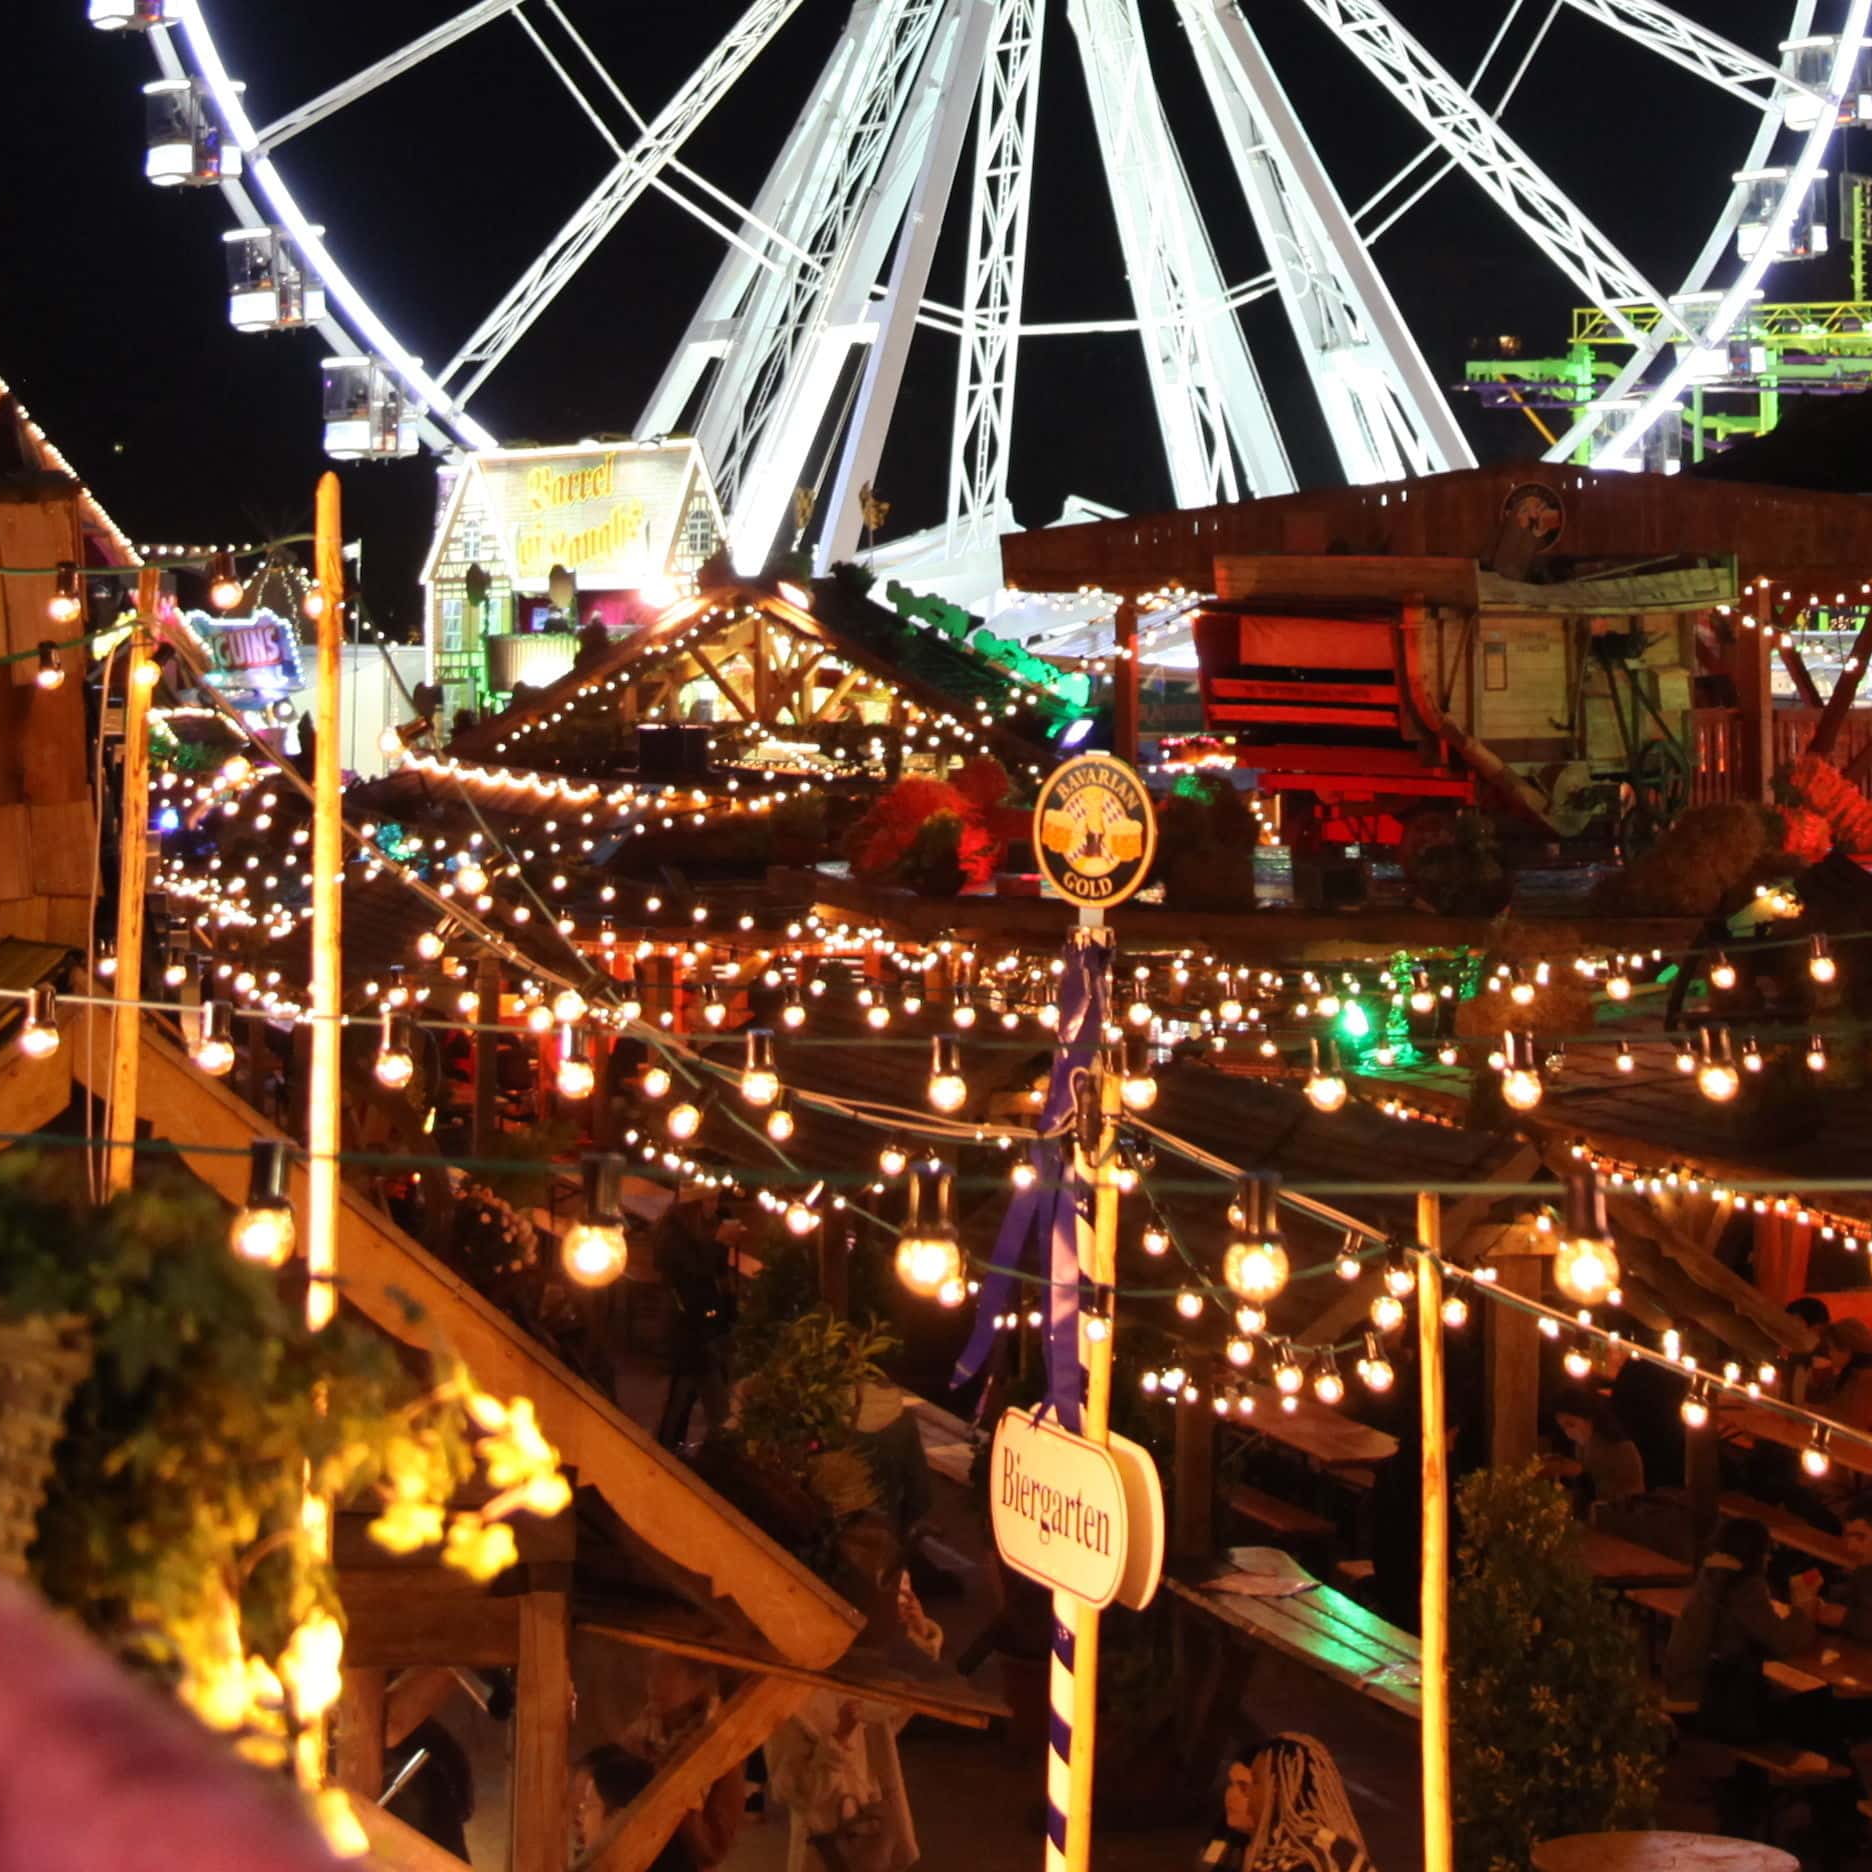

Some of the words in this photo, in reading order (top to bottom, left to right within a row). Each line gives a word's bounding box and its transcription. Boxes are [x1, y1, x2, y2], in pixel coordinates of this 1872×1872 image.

[529, 451, 617, 510] Barrel
[1056, 767, 1139, 810] BAVARIAN
[1063, 871, 1113, 896] GOLD
[1001, 1446, 1110, 1556] Biergarten
